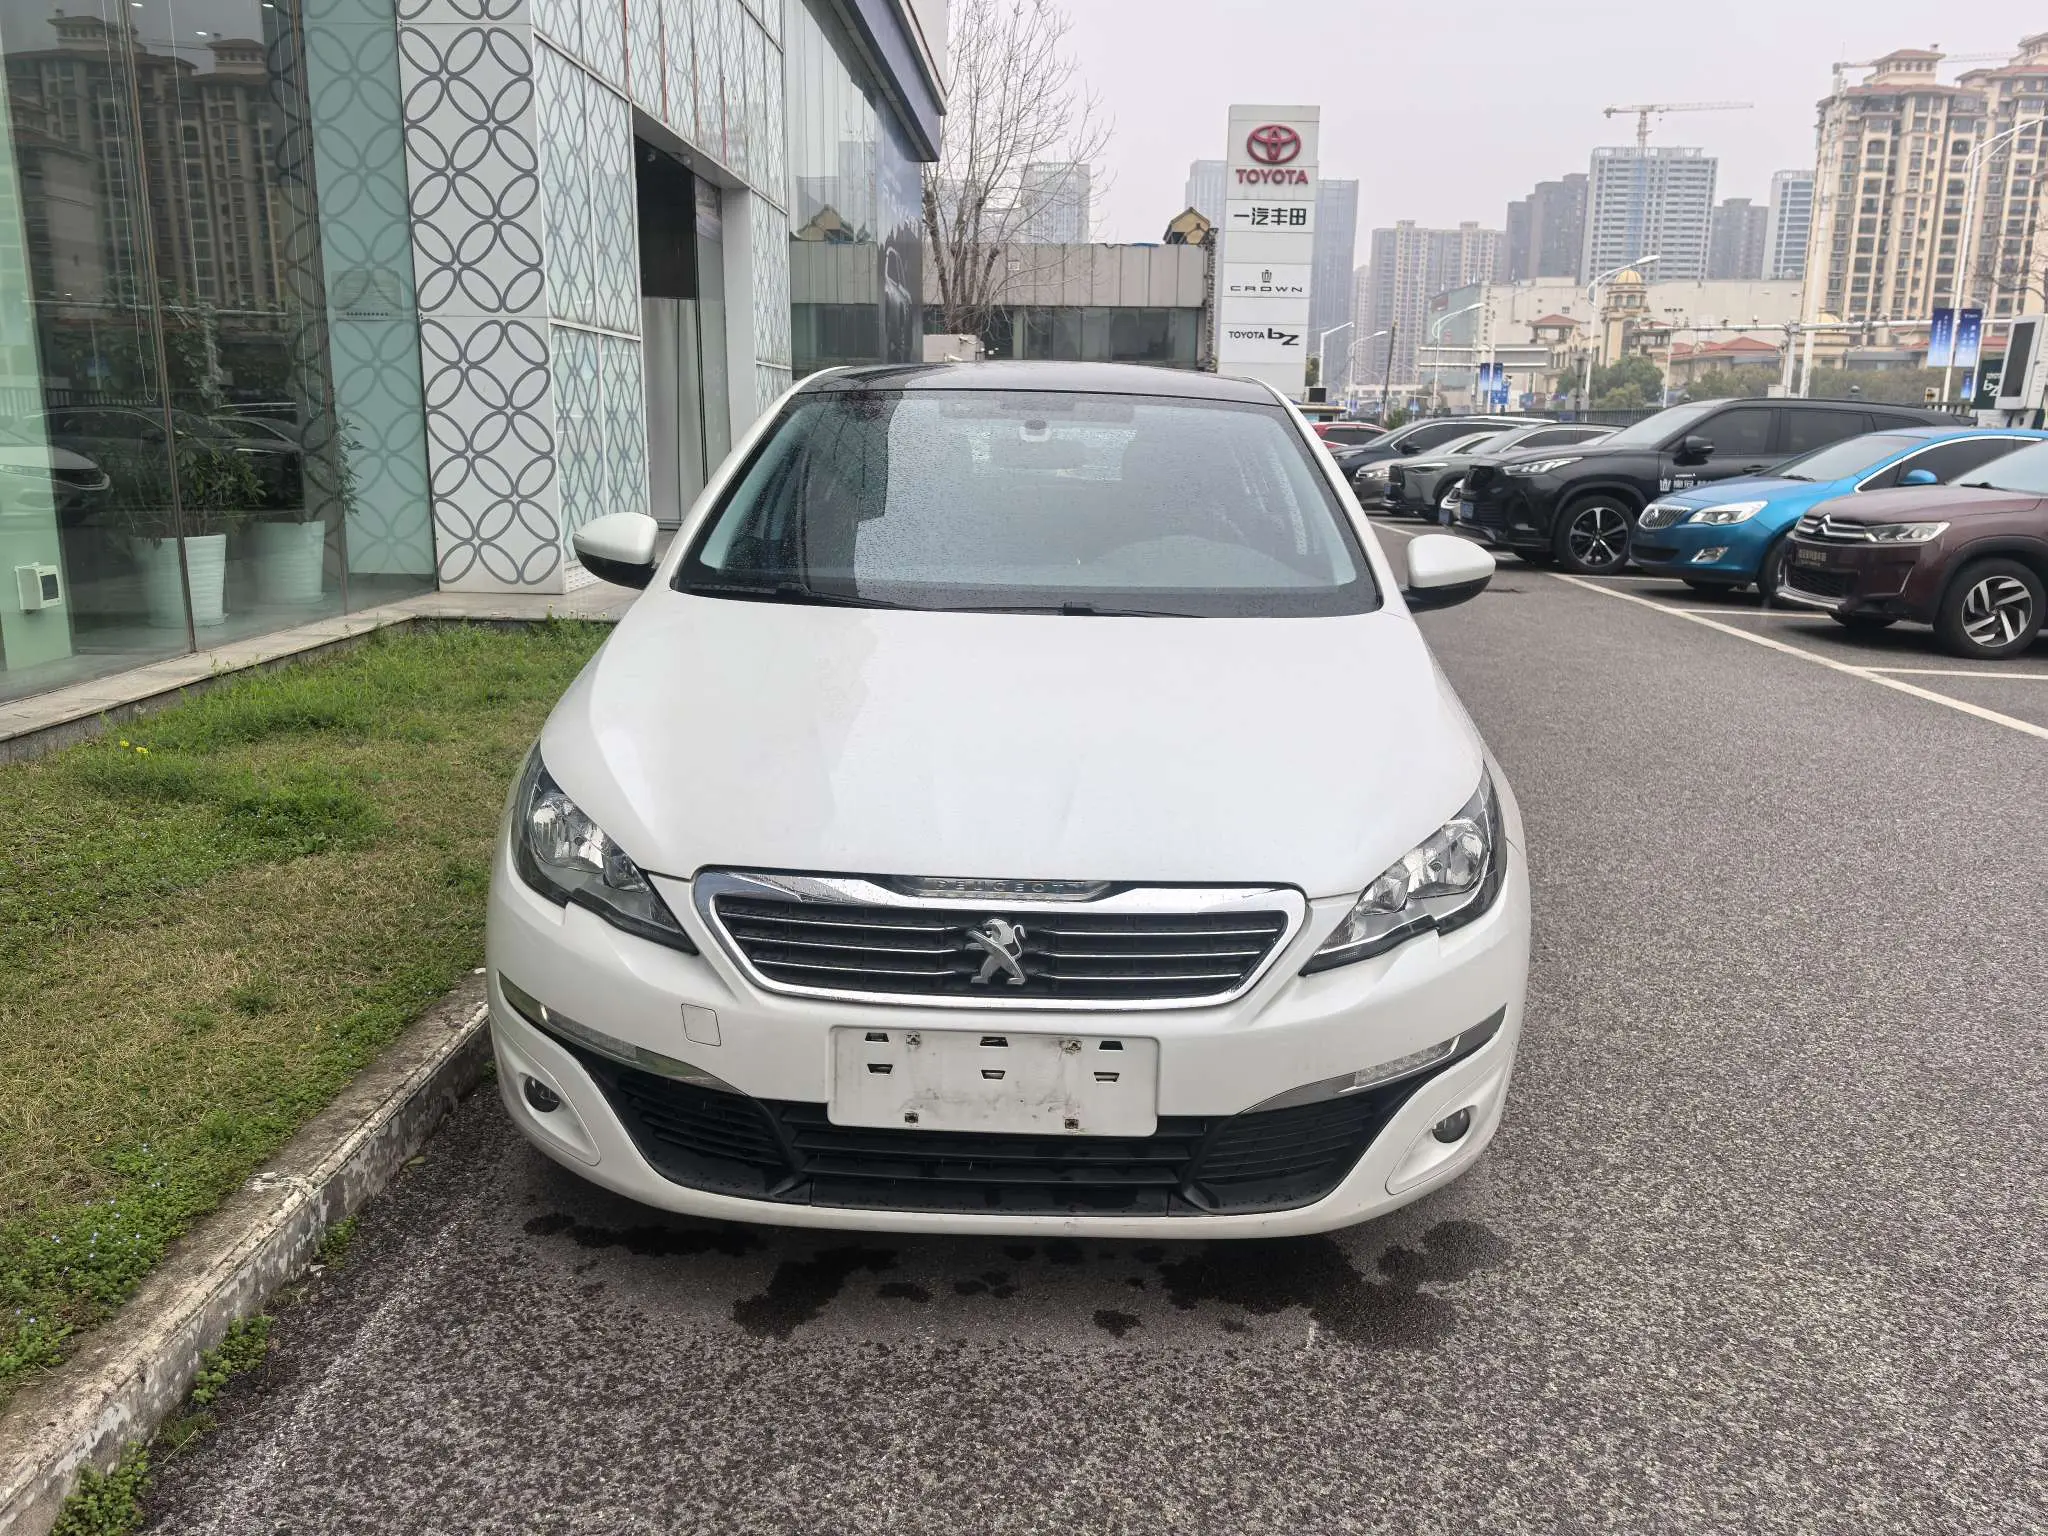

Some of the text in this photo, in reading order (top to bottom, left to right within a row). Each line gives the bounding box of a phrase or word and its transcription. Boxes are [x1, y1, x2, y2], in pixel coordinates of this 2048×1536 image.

[1235, 168, 1309, 185] TOYOTA
[1233, 207, 1307, 226] 一汽丰田
[1230, 285, 1303, 293] CROWN
[1228, 330, 1265, 340] TOYOTA
[937, 879, 1065, 894] PEUGEOT
